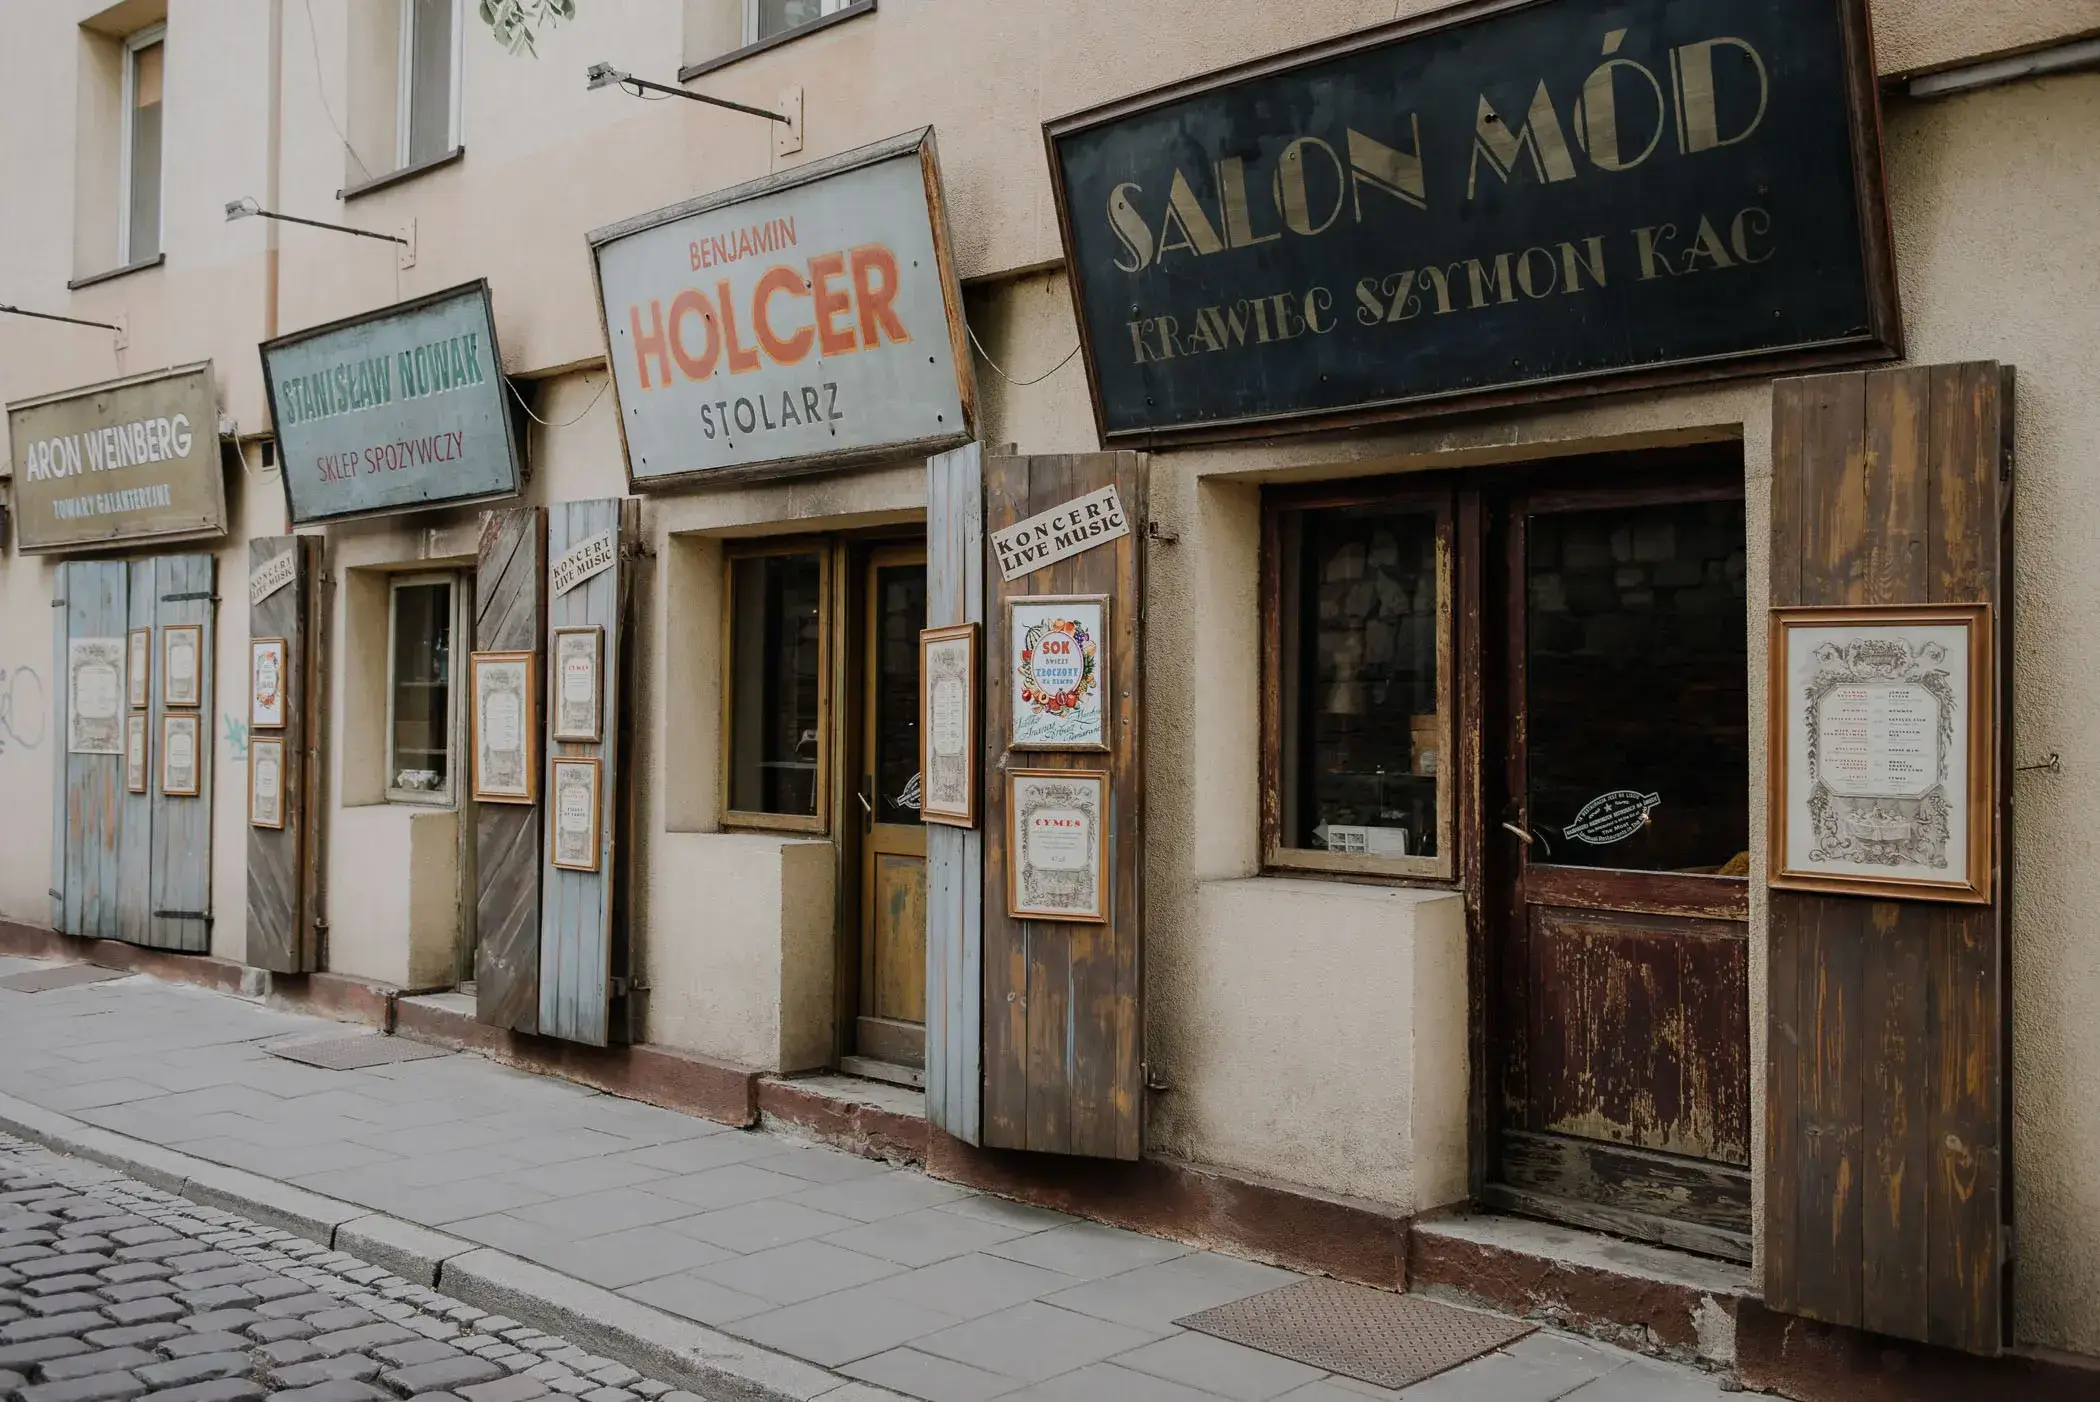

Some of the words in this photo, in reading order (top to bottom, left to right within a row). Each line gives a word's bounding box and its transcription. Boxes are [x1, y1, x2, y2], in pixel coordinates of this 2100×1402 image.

[1106, 112, 1428, 272] SALON
[1466, 28, 1768, 200] MÓD
[689, 216, 797, 271] BENJAMIN
[1126, 287, 1337, 364] KRAWIEC
[1356, 235, 1607, 326] SZYMON
[1631, 207, 1776, 281] KAC
[630, 243, 912, 391] HOLCER
[282, 356, 391, 426] STANISŁAW
[398, 333, 485, 400] NOWAK
[700, 382, 843, 439] STOLARZ
[27, 435, 82, 482] ARON
[84, 413, 192, 471] WEINBERG
[317, 452, 359, 482] SKLEP
[365, 431, 463, 474] SPOŻYWCZY
[53, 495, 95, 520] TOWARY
[997, 496, 1115, 556] KONCERT
[553, 537, 609, 578] KONCERT
[555, 569, 574, 590] LIVE
[577, 550, 612, 576] MUSIC
[1002, 542, 1049, 572] LIVE
[1054, 513, 1123, 551] MUSIC
[1042, 641, 1070, 655] SOK
[1035, 817, 1081, 827] CYMES
